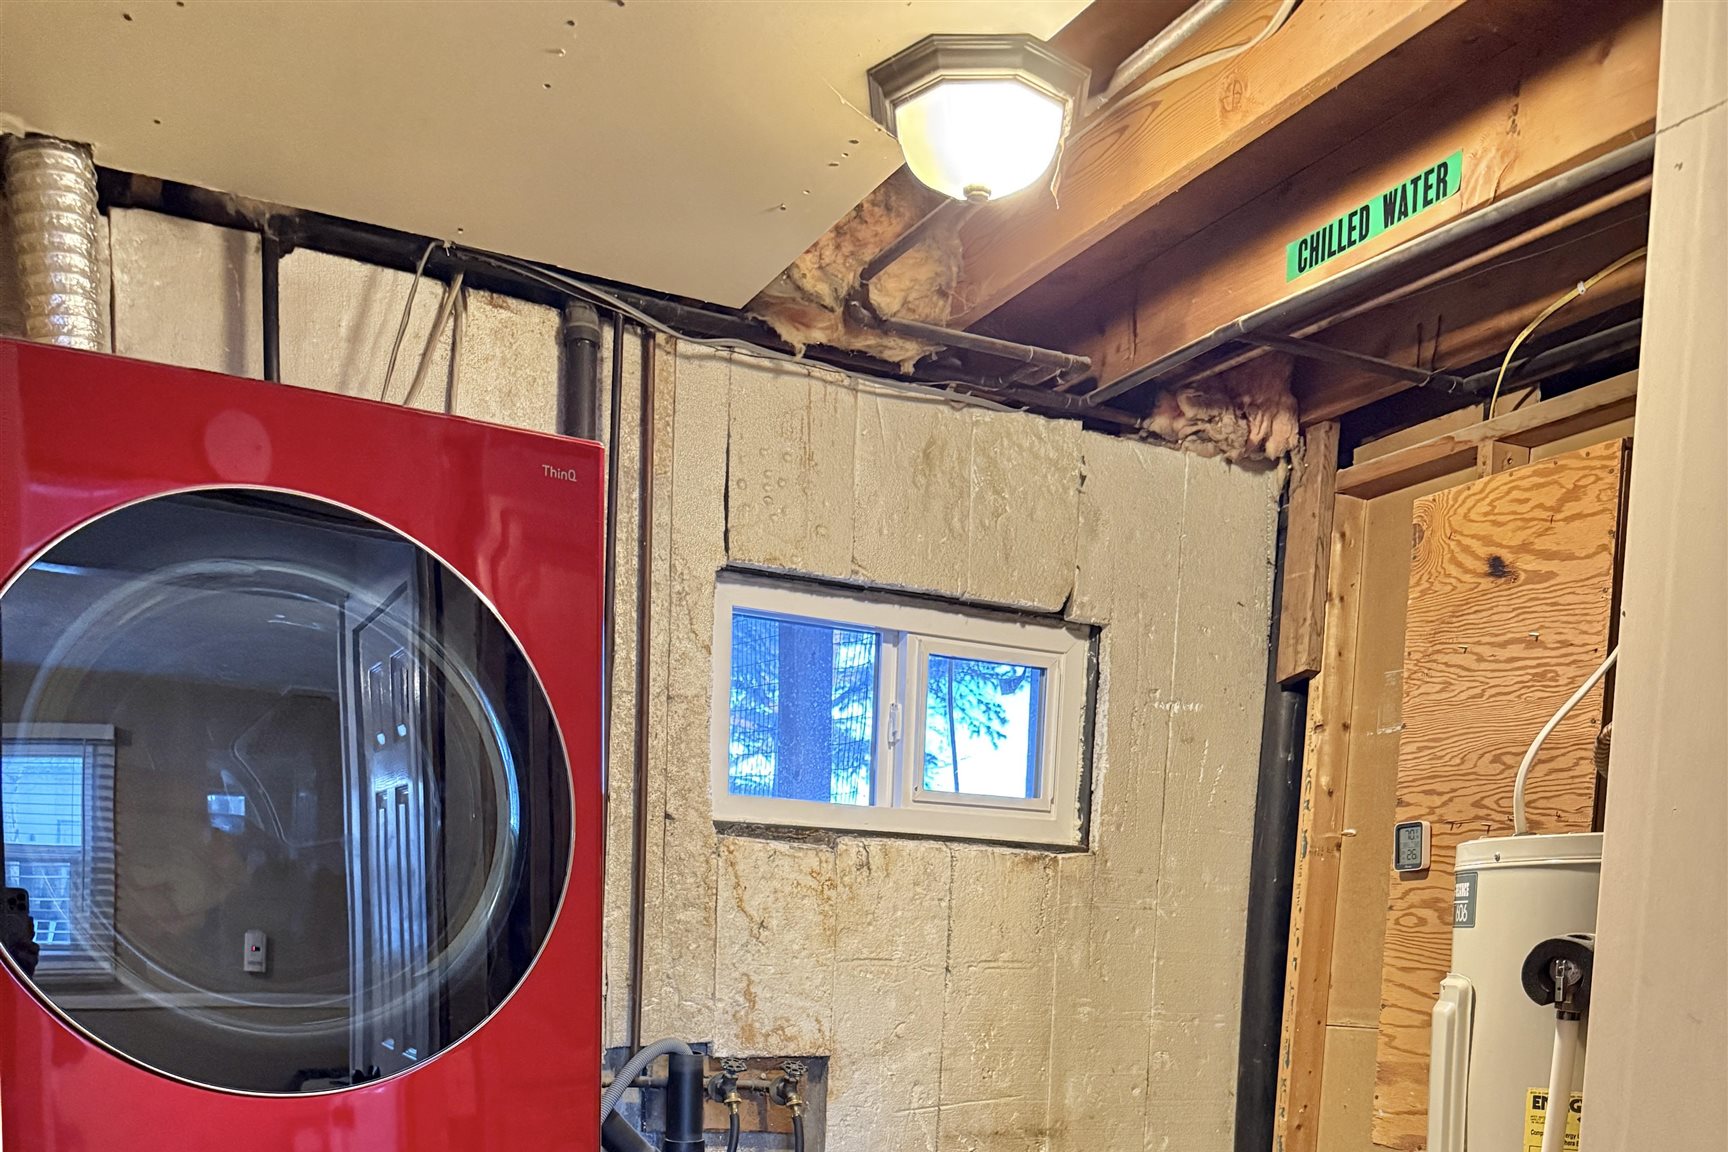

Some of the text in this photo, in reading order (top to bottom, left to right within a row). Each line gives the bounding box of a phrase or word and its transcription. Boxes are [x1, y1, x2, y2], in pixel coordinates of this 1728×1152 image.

[1297, 161, 1449, 274] CHILLED WATER
[542, 464, 577, 482] ThinQ
